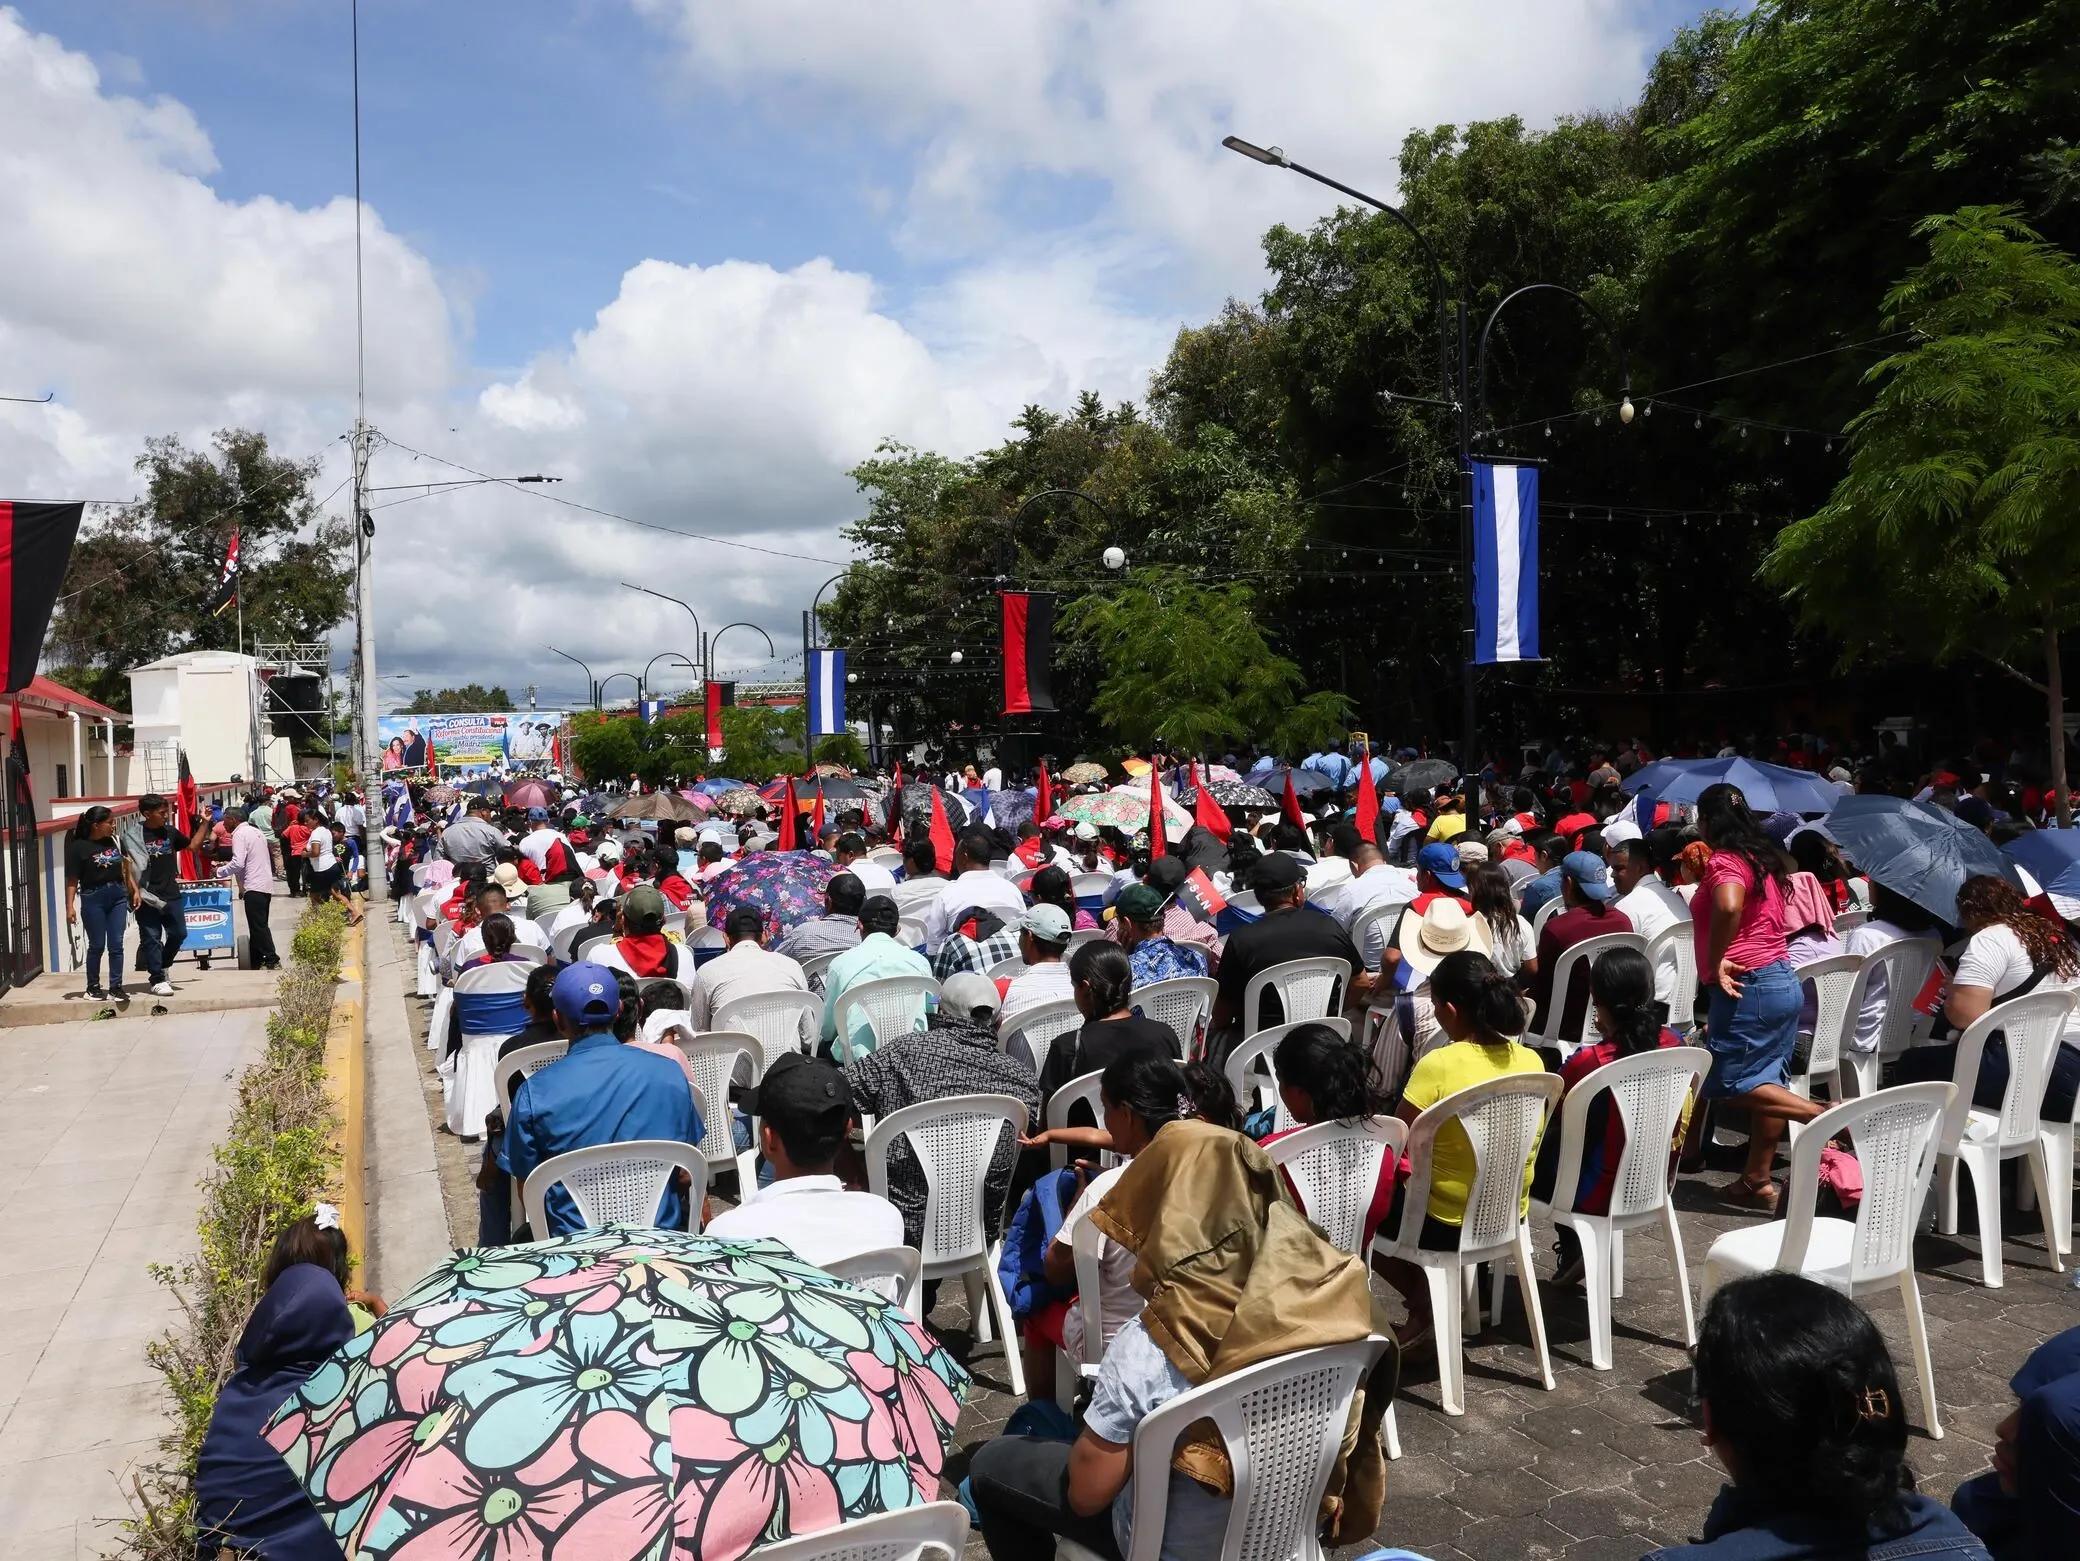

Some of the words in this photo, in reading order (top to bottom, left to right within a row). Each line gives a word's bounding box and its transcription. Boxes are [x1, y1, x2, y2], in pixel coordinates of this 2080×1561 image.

[449, 718, 485, 728] CONSULTA
[435, 728, 460, 738] Reforma
[1184, 877, 1212, 910] FSLN
[184, 914, 221, 922] SKIMO
